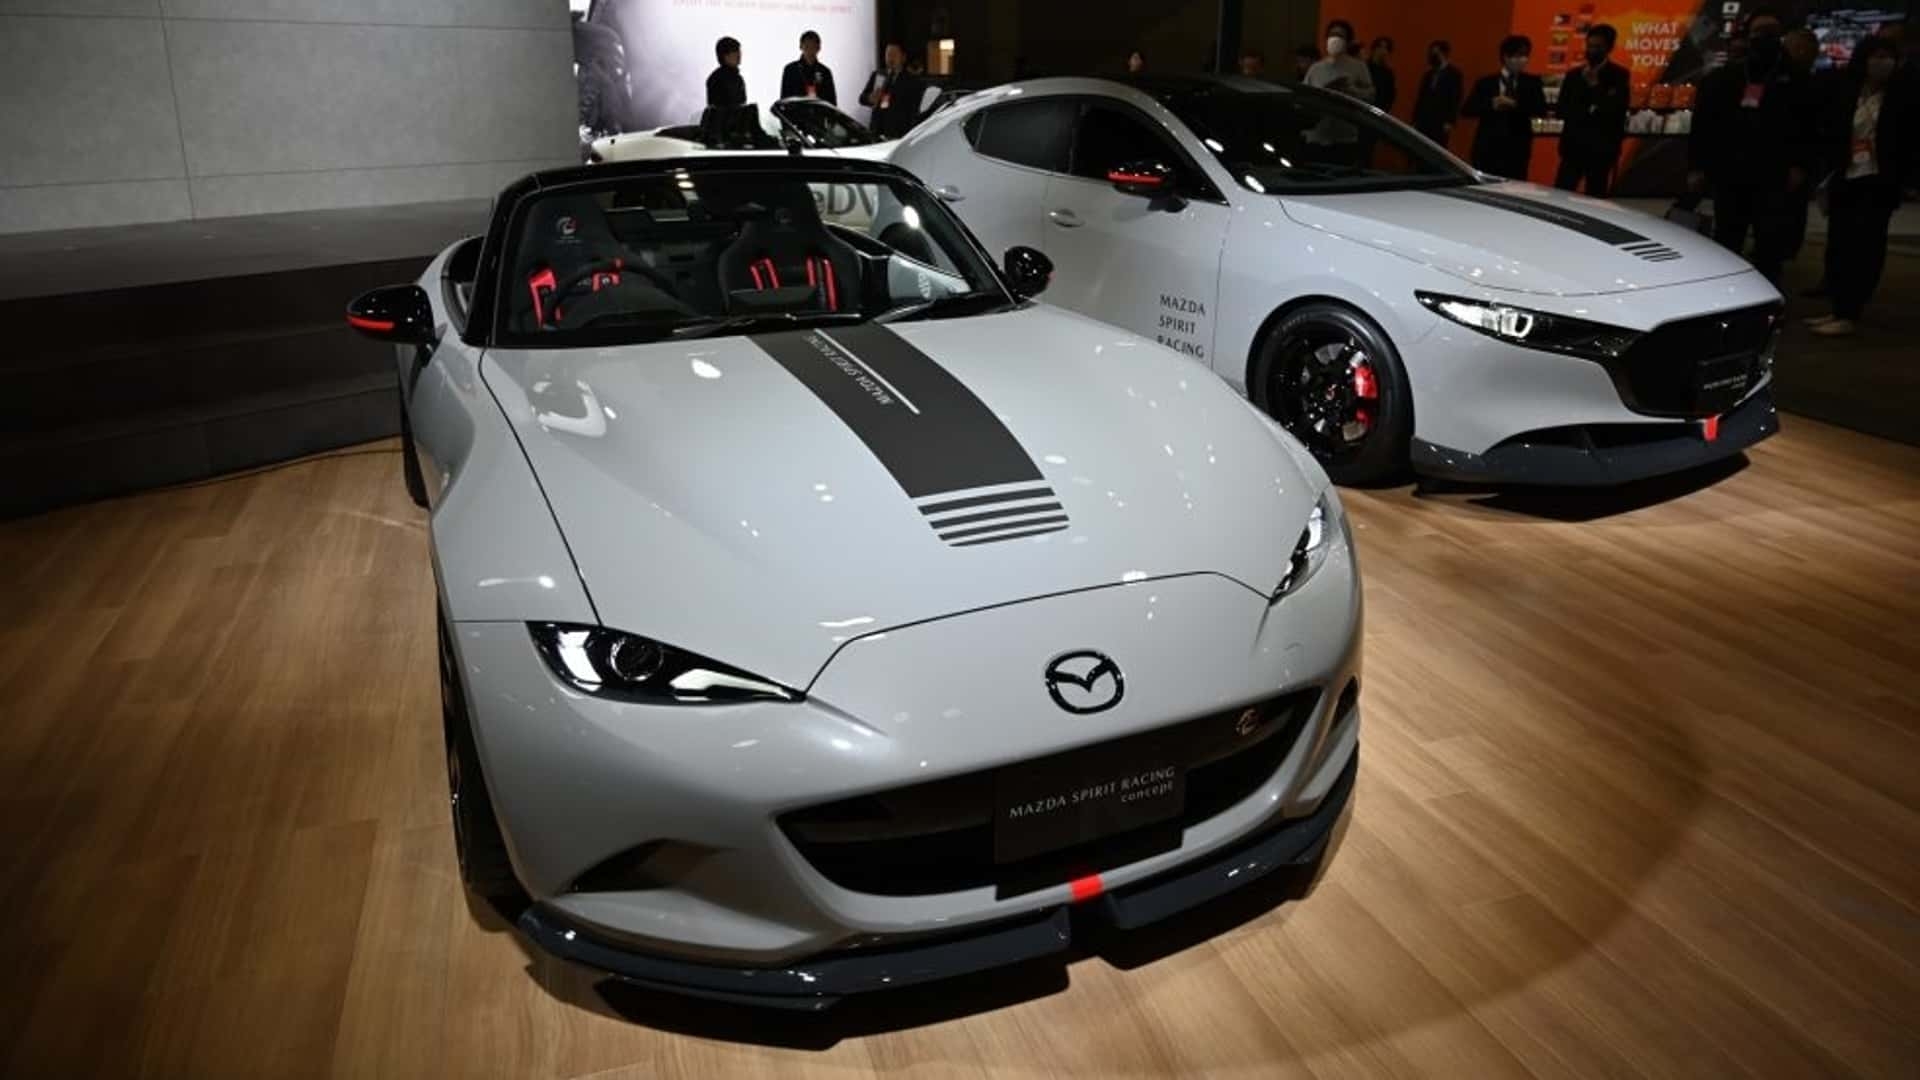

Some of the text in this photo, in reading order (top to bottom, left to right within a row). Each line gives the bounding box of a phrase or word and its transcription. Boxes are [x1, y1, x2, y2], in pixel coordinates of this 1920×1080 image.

[1632, 22, 1679, 34] WHAT
[1625, 38, 1680, 51] MOVES
[1632, 54, 1669, 67] YOU.
[1160, 295, 1206, 316] MAZDA
[1159, 315, 1195, 334] SPIRIT
[1009, 766, 1175, 818] MAZDA SPIRIT RACING
[1121, 780, 1173, 802] concept
